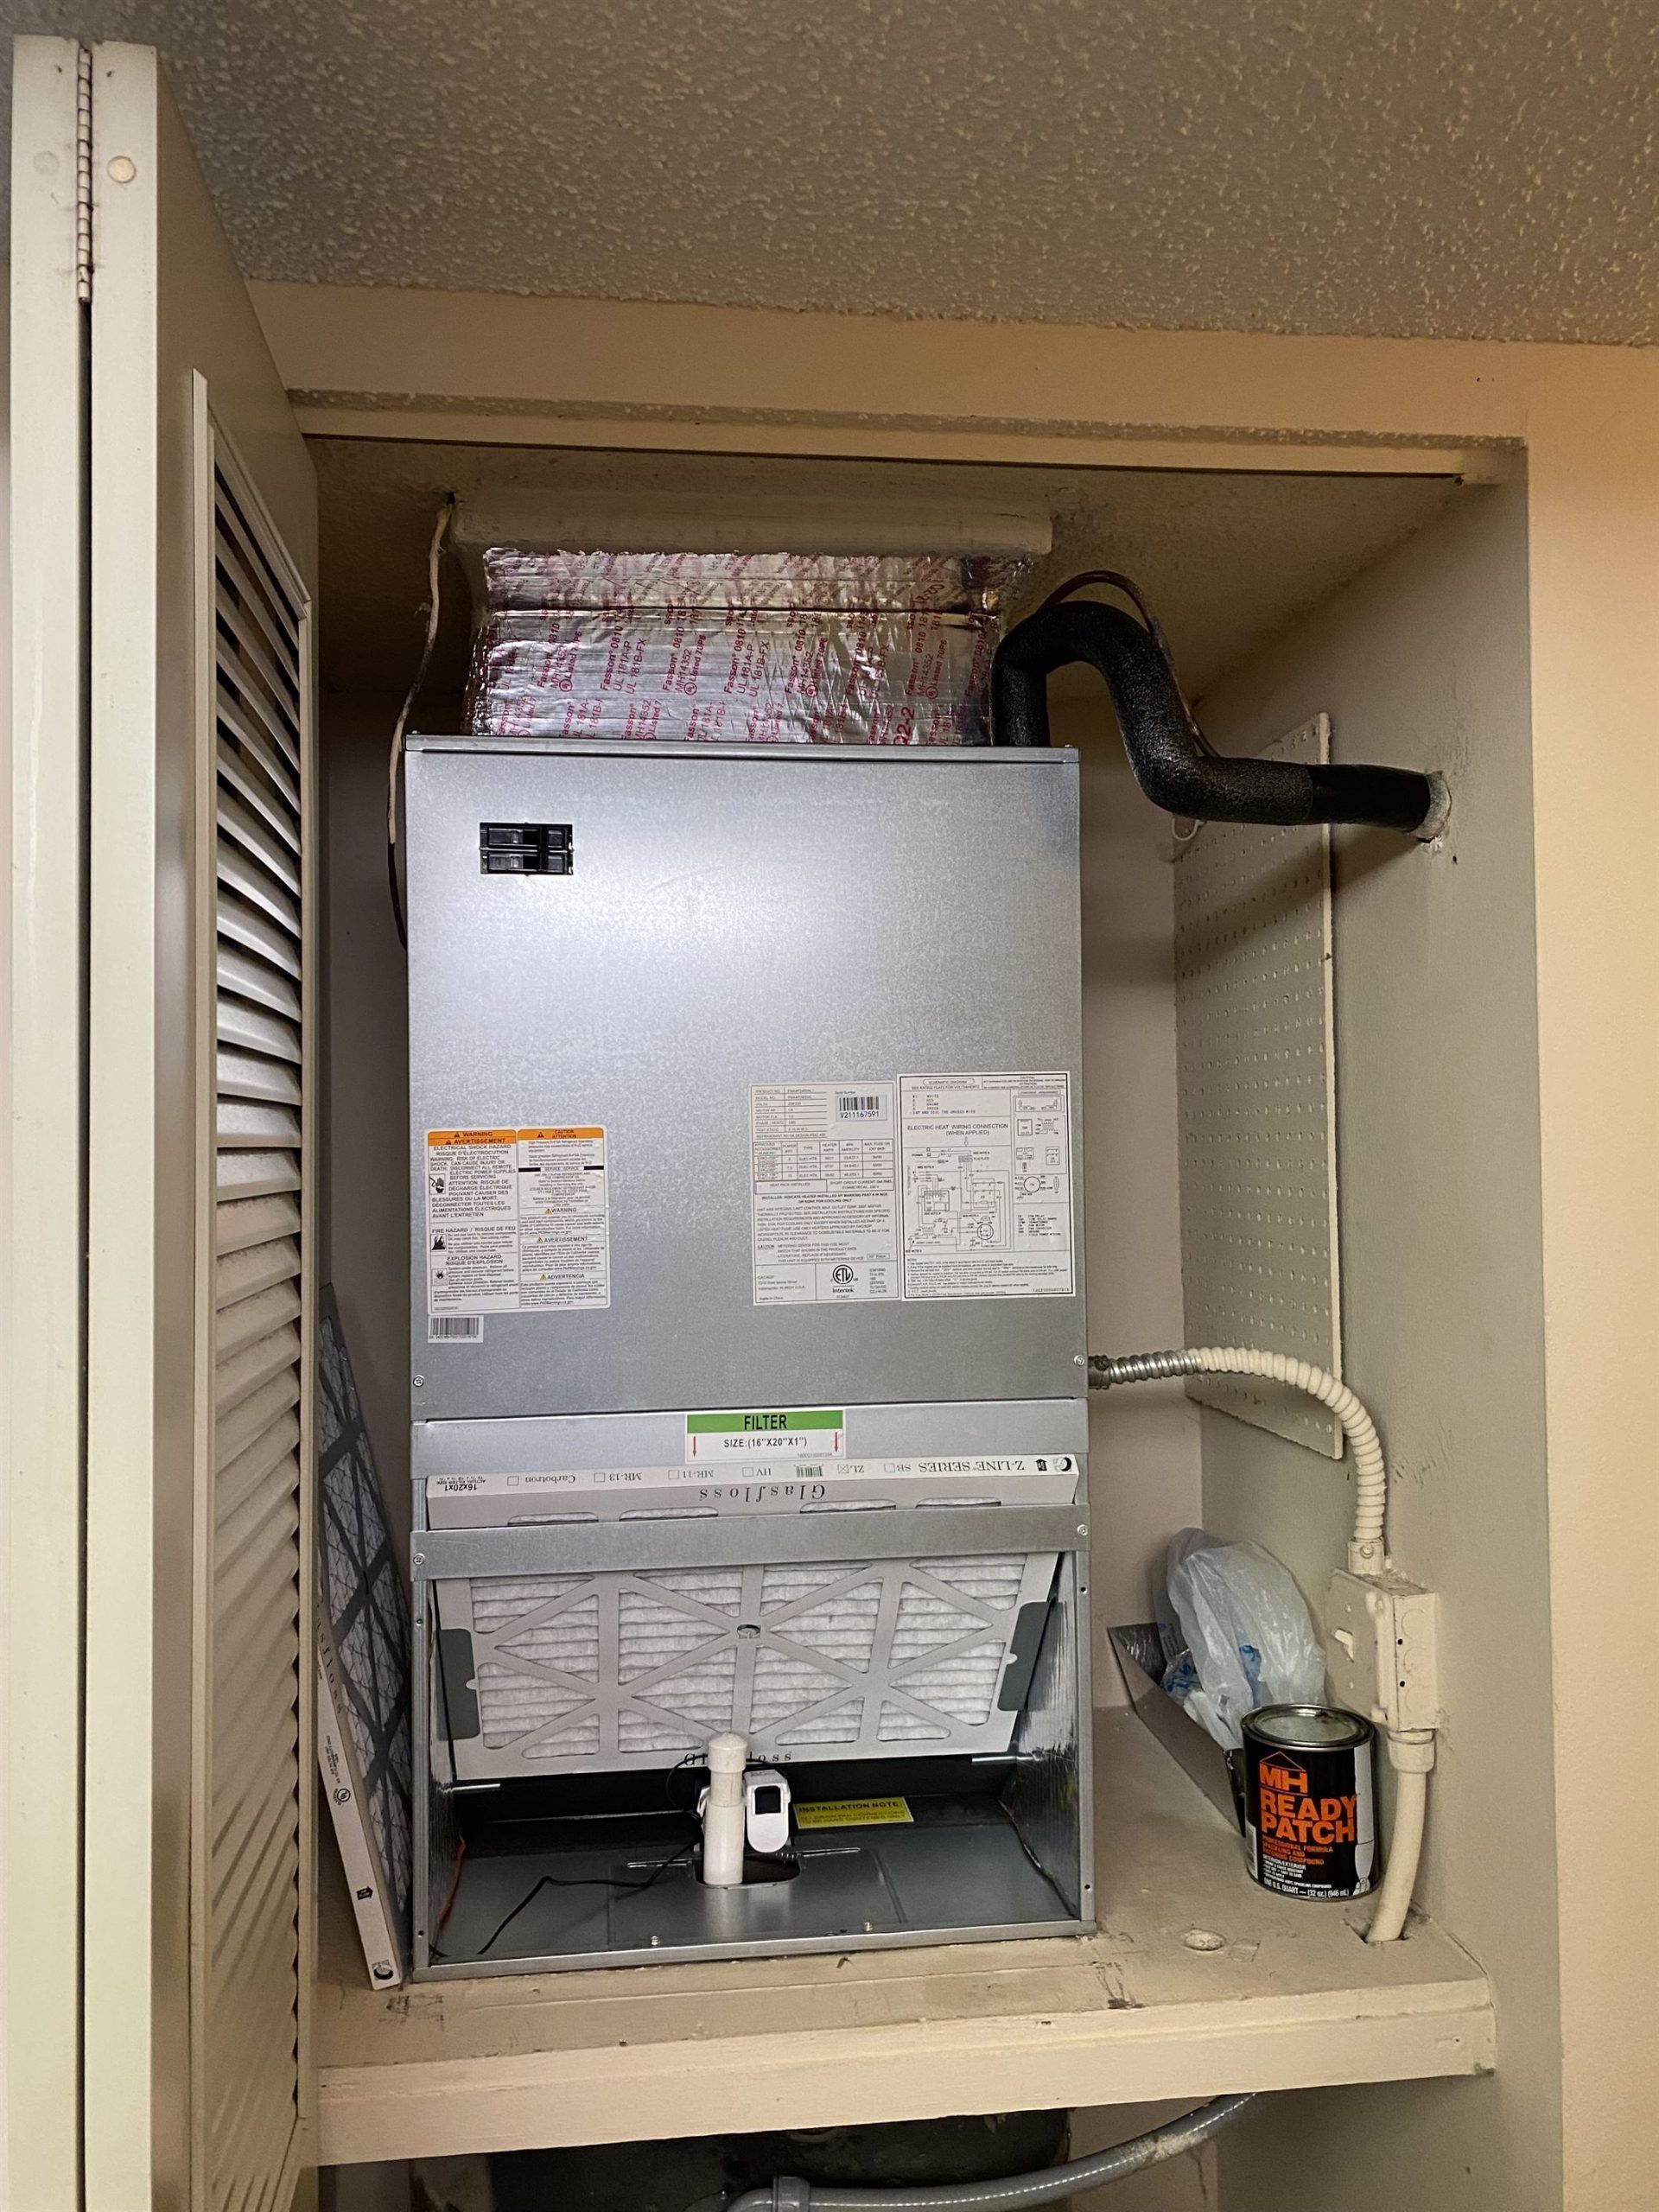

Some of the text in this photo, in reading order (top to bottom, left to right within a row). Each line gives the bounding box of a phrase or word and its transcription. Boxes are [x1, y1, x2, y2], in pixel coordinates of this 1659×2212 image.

[610, 625, 623, 649] 0810
[673, 626, 685, 649] 0810
[734, 628, 747, 652] 0810
[795, 628, 807, 652] 0810
[855, 631, 868, 655] 0810
[915, 631, 927, 653] 0810
[626, 638, 648, 694] UL 181B-FX
[675, 648, 692, 692] MH14352
[690, 655, 701, 682] Listed
[613, 677, 625, 691] UL
[737, 679, 747, 694] UL
[749, 684, 759, 697] UL
[744, 1414, 788, 1430] FILTER
[609, 1472, 642, 1481] MR-13
[682, 1469, 714, 1479] MR-11
[756, 1467, 772, 1477] HV
[849, 1464, 864, 1473] ZL
[918, 1461, 970, 1473] SERIES
[444, 1483, 477, 1492] 16x20x1
[524, 1473, 576, 1484] Carbotron
[699, 1483, 825, 1504] Glasfloss
[1260, 1763, 1308, 1793] MH
[799, 1803, 870, 1813] INSTALLATION
[1260, 1789, 1357, 1821] READY
[1261, 1810, 1355, 1844] PATCH
